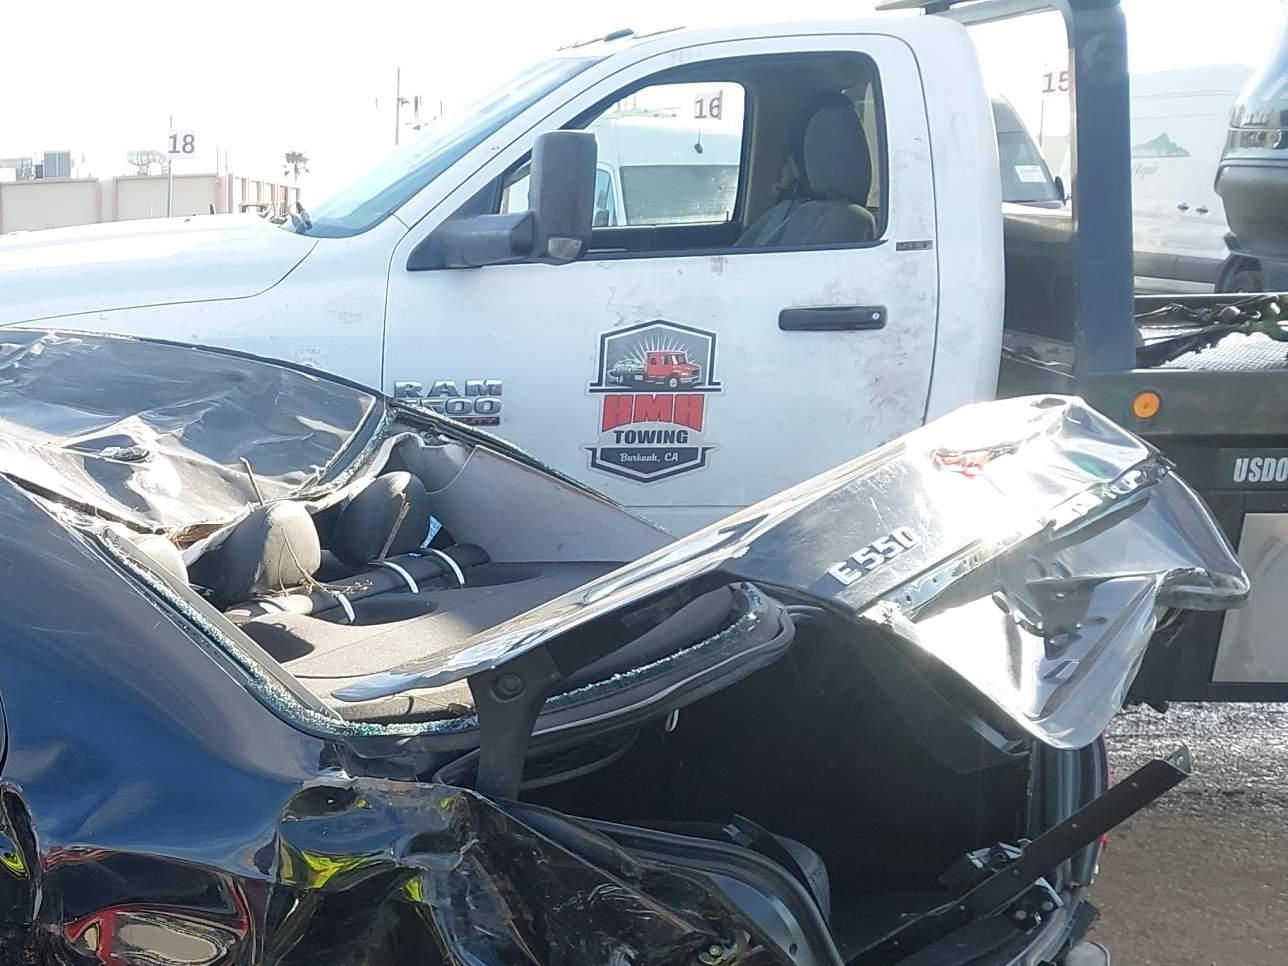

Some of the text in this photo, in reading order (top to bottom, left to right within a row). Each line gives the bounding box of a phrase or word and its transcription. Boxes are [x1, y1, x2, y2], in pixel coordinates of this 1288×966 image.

[1041, 70, 1070, 93] 15
[694, 96, 721, 119] 16
[168, 133, 196, 154] 18
[393, 379, 503, 398] RAM
[601, 393, 705, 433] HMH
[613, 428, 689, 445] TOWING
[619, 452, 680, 464] Burbank, CA
